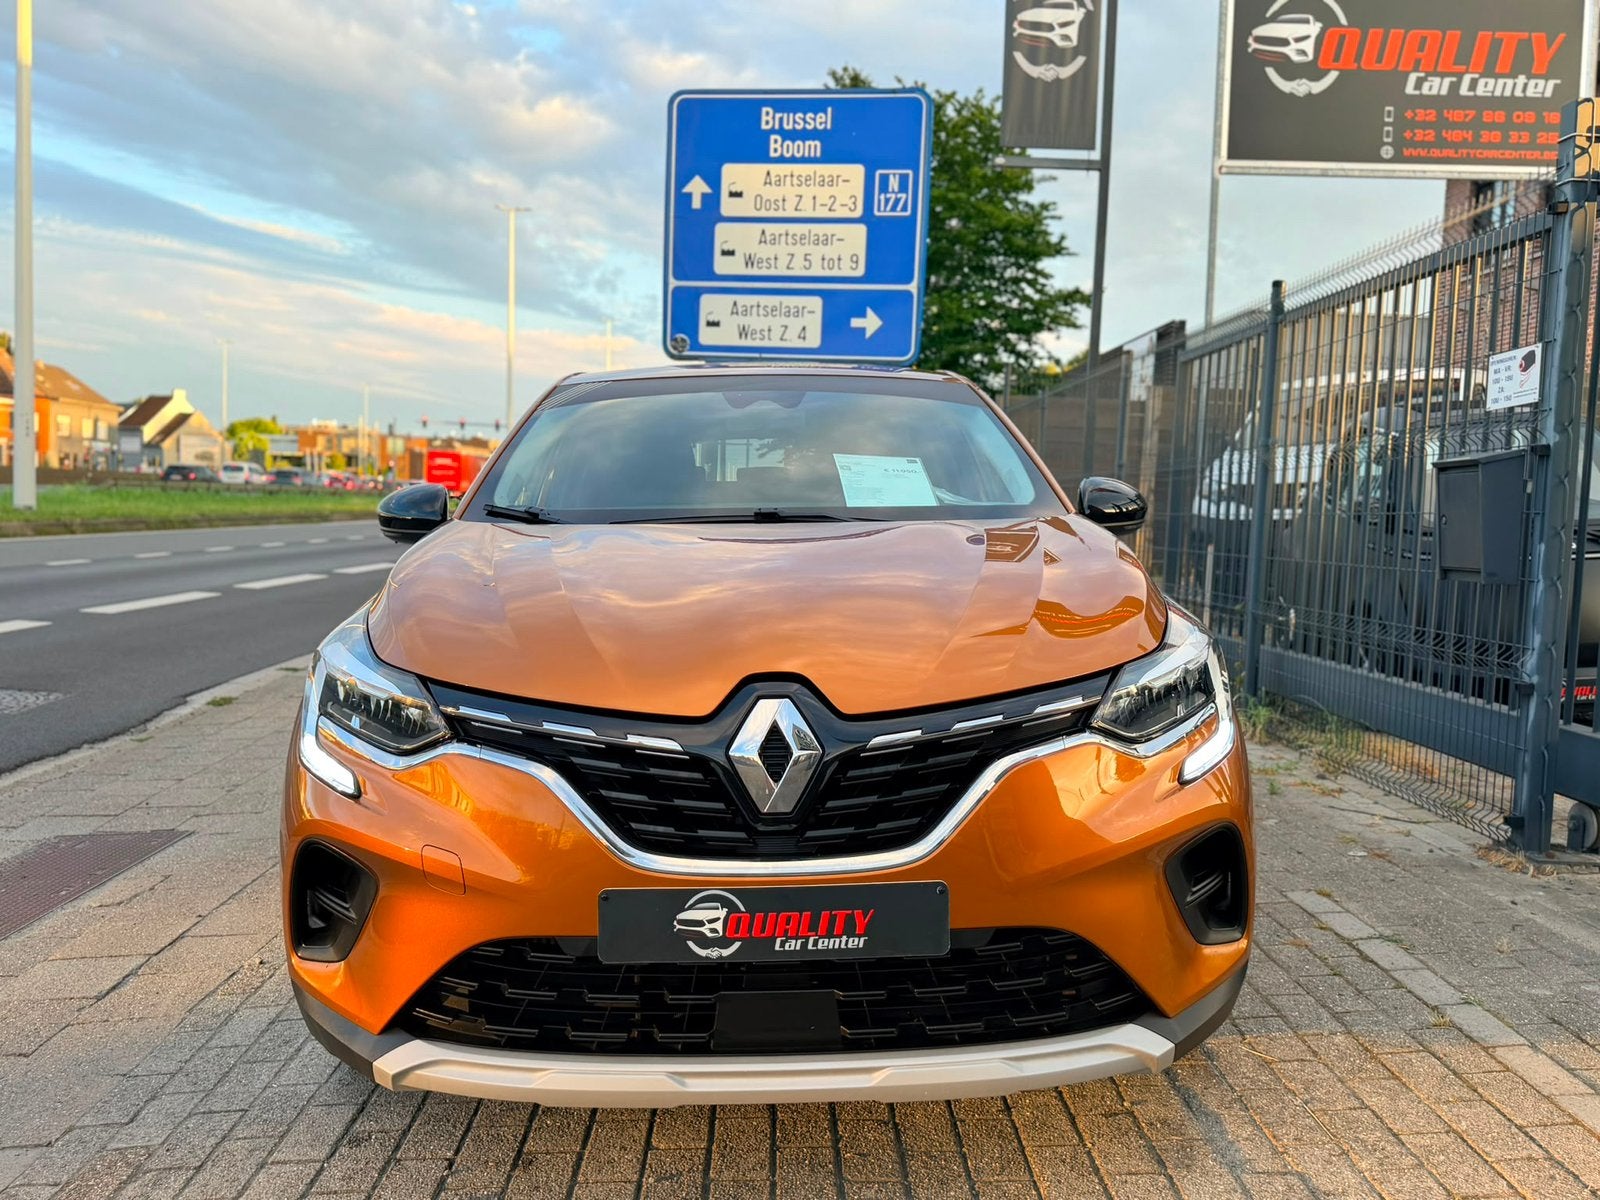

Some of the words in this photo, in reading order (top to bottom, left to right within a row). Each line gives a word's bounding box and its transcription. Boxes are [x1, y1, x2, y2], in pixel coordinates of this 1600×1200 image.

[1318, 27, 1567, 74] QUALITY
[1405, 72, 1457, 95] Car
[1459, 73, 1562, 98] Center
[760, 106, 833, 130] Brussel
[1403, 108, 1437, 122] +32
[1402, 128, 1436, 142] +32
[769, 134, 821, 158] Boom
[763, 169, 851, 188] Aartselaar-
[888, 173, 900, 192] N
[753, 193, 787, 212] Oost
[879, 193, 907, 212] 177
[758, 229, 845, 247] Aartselaar-
[743, 252, 779, 270] West
[820, 254, 843, 271] tot
[849, 253, 860, 272] 9
[730, 300, 816, 318] Aartselaar-
[737, 324, 773, 341] West
[797, 325, 807, 342] 4
[725, 909, 875, 938] QUALITY
[774, 937, 806, 951] Car
[807, 935, 869, 950] Center
